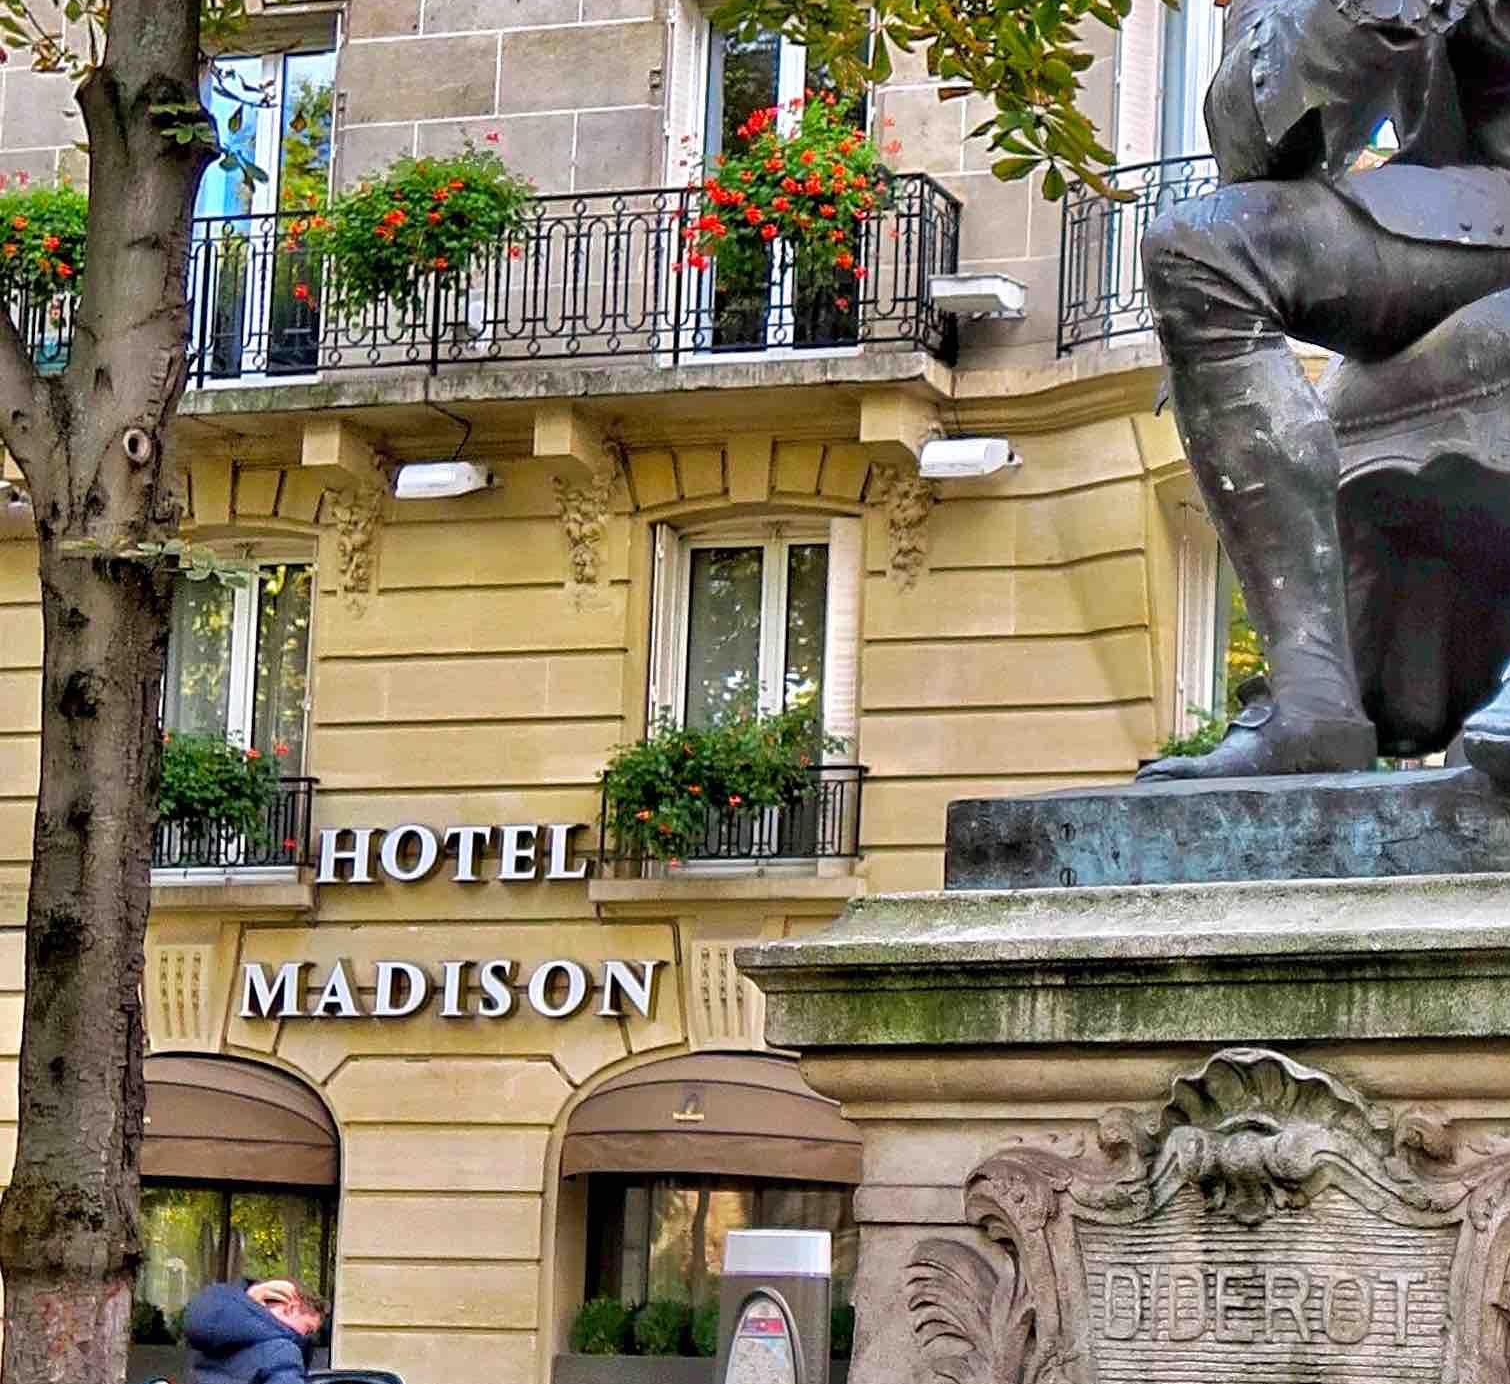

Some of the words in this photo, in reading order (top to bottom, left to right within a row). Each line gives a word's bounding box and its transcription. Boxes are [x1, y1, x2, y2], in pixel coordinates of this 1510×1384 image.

[315, 823, 592, 884] HOTEL
[240, 958, 664, 1018] MADISON
[1103, 1265, 1426, 1346] DIDEROT
